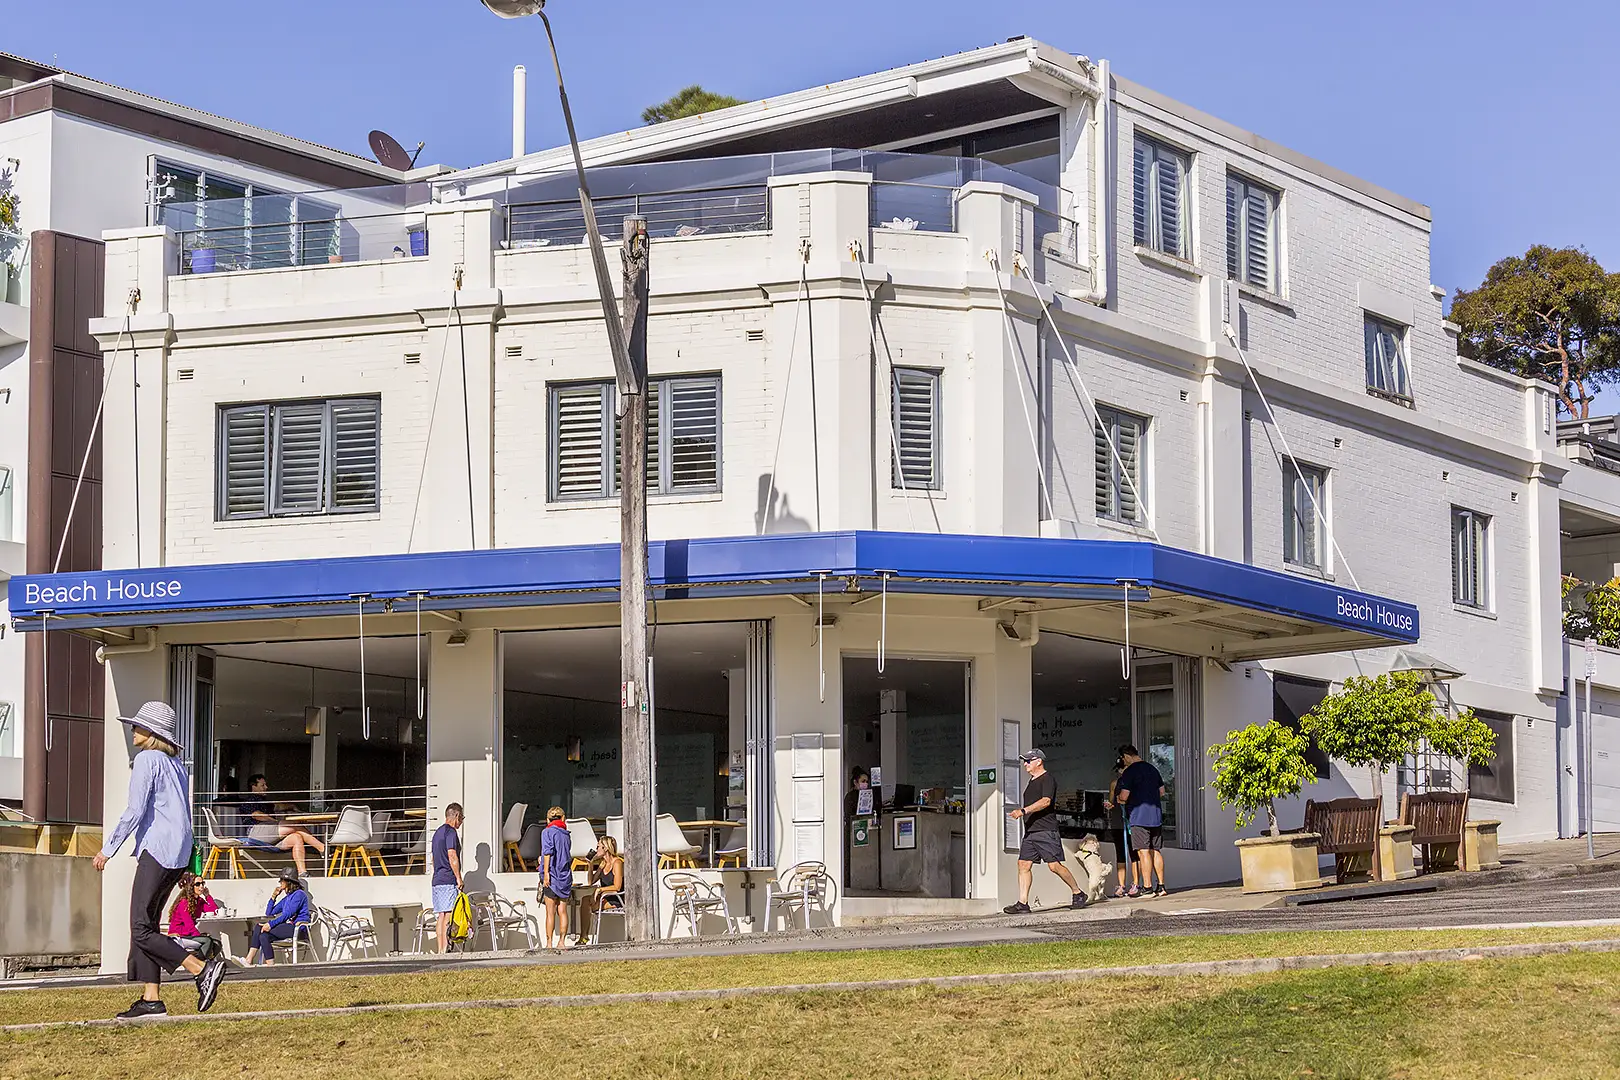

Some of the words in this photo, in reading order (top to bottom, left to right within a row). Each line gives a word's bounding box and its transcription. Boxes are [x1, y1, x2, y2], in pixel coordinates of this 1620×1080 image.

[25, 580, 97, 604] Beach
[106, 578, 182, 600] House
[1336, 595, 1373, 622] Beach
[1376, 604, 1413, 631] House
[1032, 718, 1048, 730] ach
[1054, 714, 1083, 729] House
